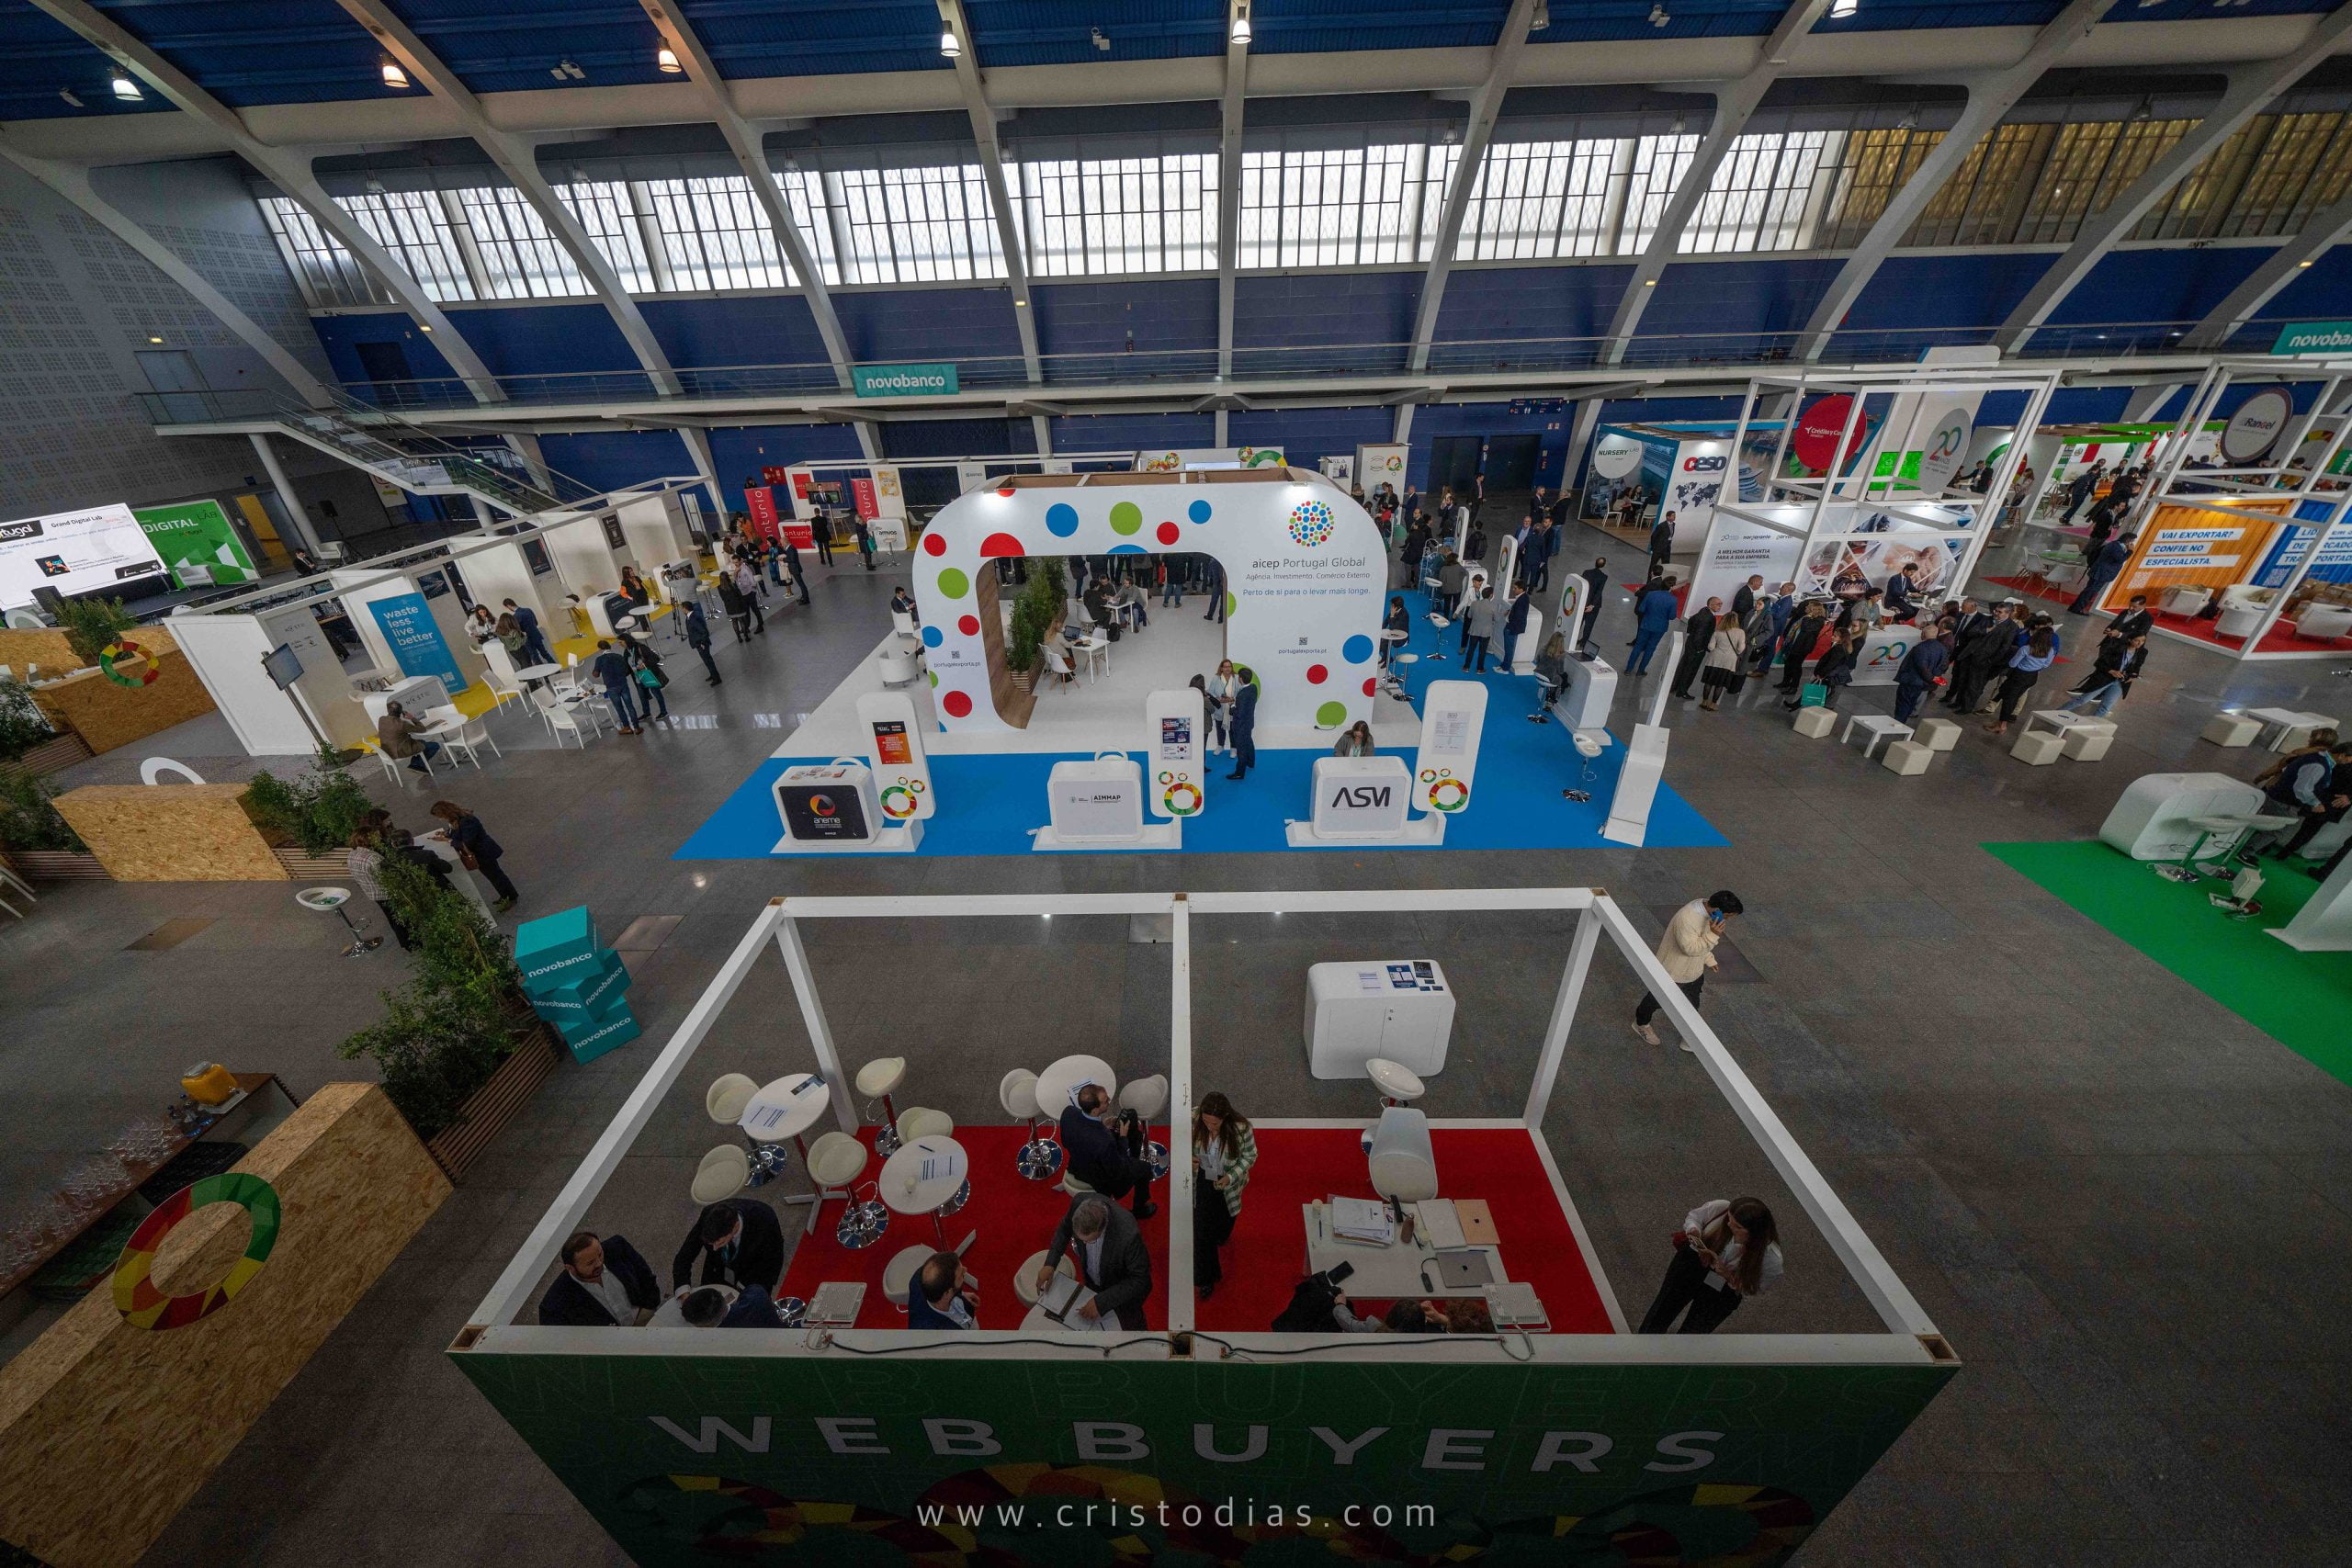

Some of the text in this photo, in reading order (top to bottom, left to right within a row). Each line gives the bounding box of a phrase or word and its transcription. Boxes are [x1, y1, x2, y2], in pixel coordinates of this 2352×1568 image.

[866, 374, 944, 389] novobanco
[2245, 418, 2276, 430] Rangel
[72, 517, 91, 525] Digital
[141, 518, 198, 534] DIGITAL
[0, 524, 34, 537] rtugal
[2179, 531, 2233, 539] EXPORTAR?
[2153, 545, 2189, 553] CONFIE
[1252, 558, 1366, 570] aicep Portugal Global
[2145, 557, 2211, 566] ESPECIALISTA.
[1283, 589, 1301, 597] para
[1348, 587, 1371, 596] longe.
[383, 605, 419, 620] waste
[389, 618, 415, 629] less.
[393, 626, 414, 637] live
[397, 631, 434, 647] better
[1332, 787, 1391, 807] ASM
[527, 953, 593, 977] novobanco
[585, 966, 623, 1006] novobanco
[533, 1000, 582, 1009] novobanco
[573, 1017, 631, 1049] novobanco
[647, 1416, 1727, 1472] WEB BUYERS
